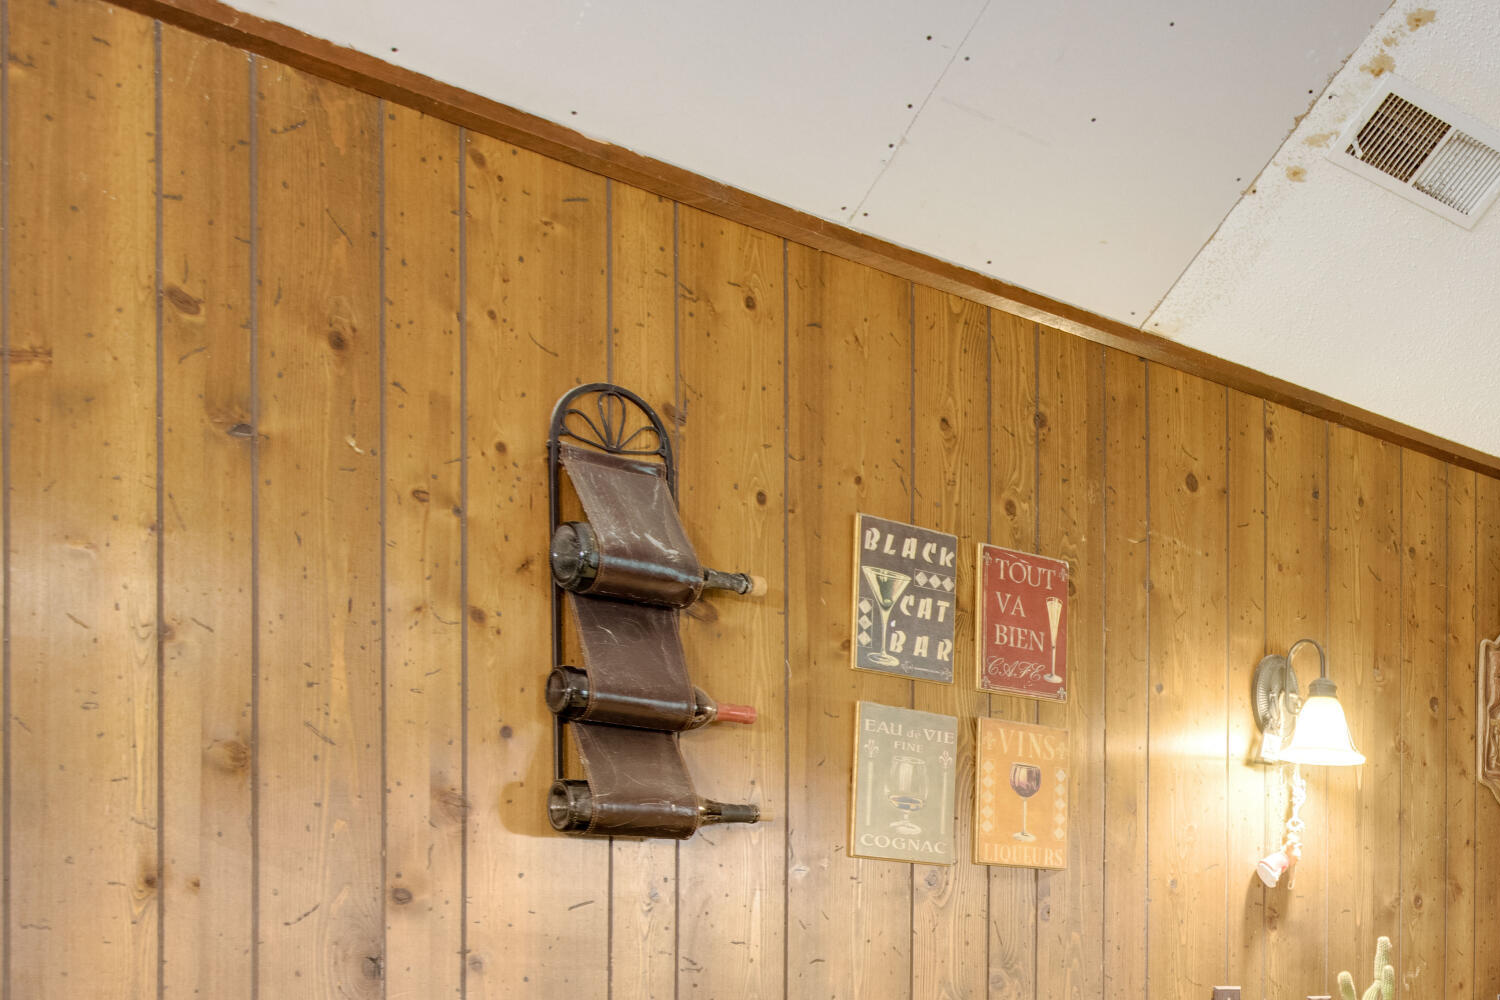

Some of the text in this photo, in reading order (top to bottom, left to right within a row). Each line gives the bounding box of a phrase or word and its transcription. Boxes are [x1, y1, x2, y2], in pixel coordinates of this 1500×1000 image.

[864, 527, 955, 568] BLACK
[994, 557, 1057, 591] TOUT
[899, 595, 951, 623] CAT
[995, 591, 1026, 618] VA
[889, 630, 953, 662] BAR
[994, 624, 1045, 653] BIEN
[864, 718, 955, 745] EAU de VIE
[999, 728, 1056, 761] VINS
[893, 740, 924, 753] FINE
[860, 833, 948, 854] COGNAC
[984, 843, 1064, 867] LIQUEURS
